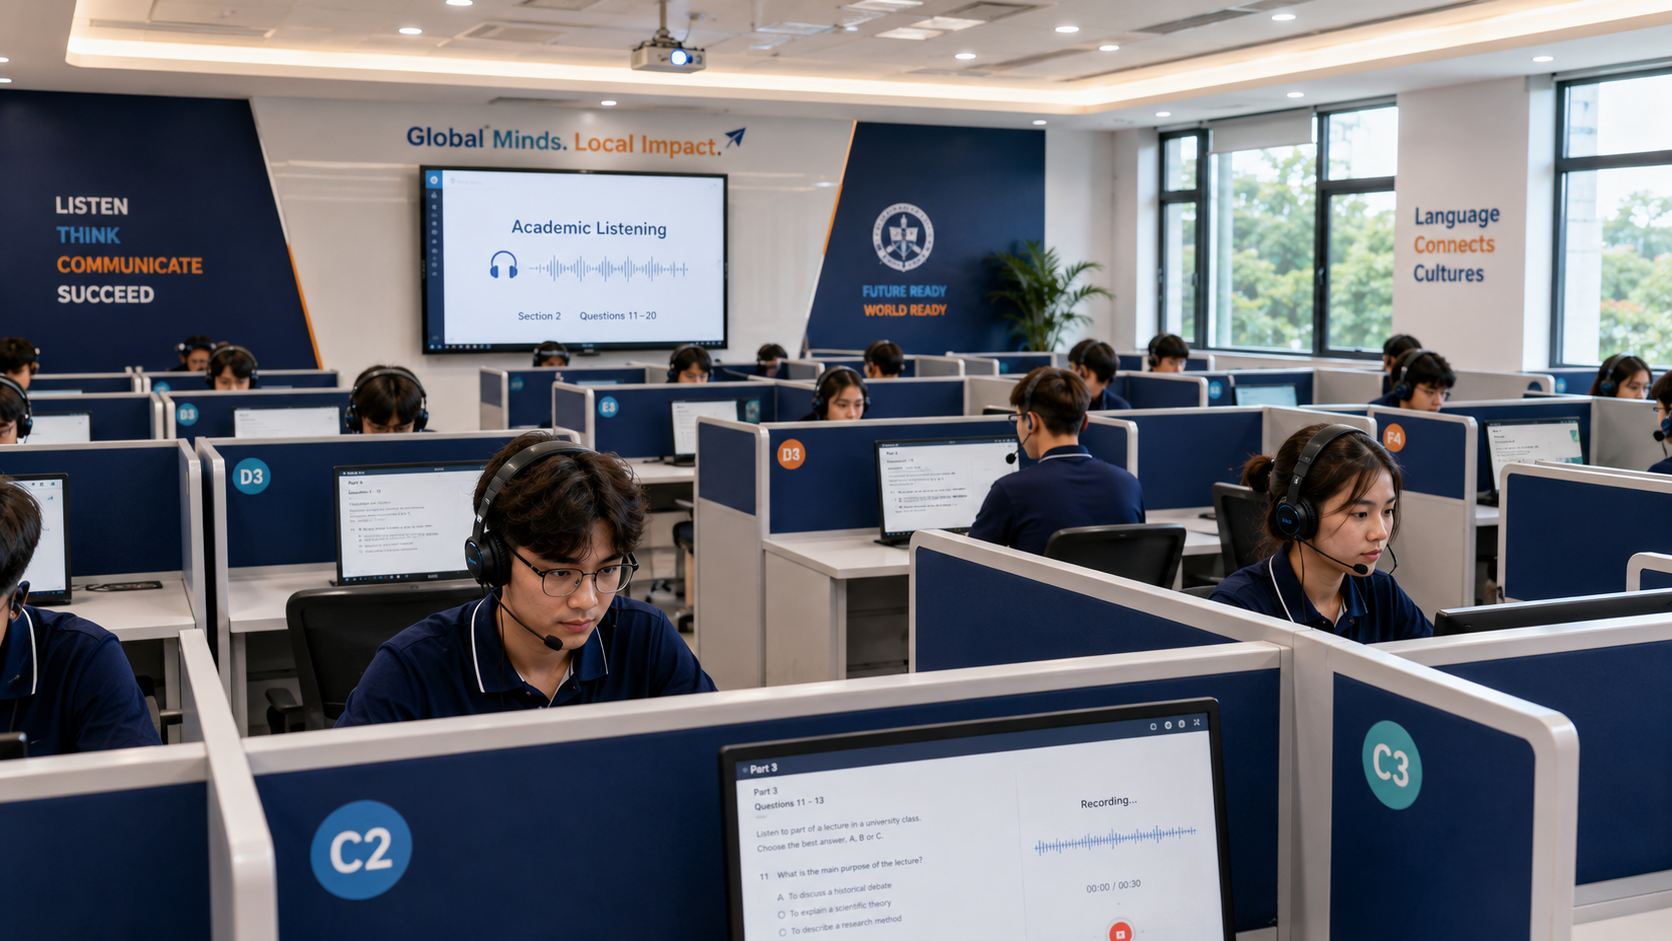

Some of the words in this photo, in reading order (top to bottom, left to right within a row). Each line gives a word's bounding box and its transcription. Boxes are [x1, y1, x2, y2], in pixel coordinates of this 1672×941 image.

[407, 126, 484, 148] Global
[493, 129, 568, 151] Minds.
[574, 132, 634, 154] Local
[642, 134, 722, 160] Impact.
[56, 196, 129, 216] LISTEN
[1415, 207, 1501, 229] Language
[56, 226, 121, 245] THINK
[511, 219, 591, 236] Academic
[596, 220, 668, 240] Listening
[1414, 235, 1496, 254] Connects
[57, 255, 204, 275] COMMUNICATE
[1413, 264, 1485, 283] Cultures
[57, 284, 155, 304] SUCCEED
[862, 285, 907, 298] FUTURE
[910, 284, 947, 298] READY
[518, 311, 554, 321] Section
[555, 311, 562, 321] 2
[579, 310, 626, 322] Questions
[863, 304, 908, 317] WORLD
[910, 304, 947, 317] READY
[180, 409, 195, 421] D3
[1387, 431, 1402, 445] F4
[783, 447, 801, 462] D3
[240, 468, 264, 486] D3
[750, 763, 770, 774] Part
[771, 763, 778, 772] 3
[1373, 743, 1409, 787] C3
[754, 788, 771, 796] Part
[773, 787, 778, 795] 3
[754, 799, 795, 811] Questions
[797, 798, 806, 806] 11
[815, 797, 825, 805] 13
[1081, 796, 1138, 809] Recording...
[756, 829, 779, 838] Listen
[781, 828, 789, 836] to
[791, 826, 806, 837] part
[808, 825, 816, 833] of
[824, 821, 849, 831] lecture
[851, 820, 858, 828] in
[866, 817, 900, 830] university
[902, 814, 922, 824] class.
[330, 827, 393, 874] C2
[757, 842, 786, 852] Choose
[788, 841, 800, 849] the
[802, 839, 818, 848] best
[867, 833, 875, 841] or
[777, 870, 797, 879] What
[800, 868, 806, 876] is
[807, 867, 819, 876] the
[821, 866, 839, 874] main
[841, 863, 870, 873] purpose
[872, 861, 880, 869] of
[881, 859, 893, 868] the
[895, 856, 923, 866] lecture?
[789, 892, 798, 900] To
[800, 889, 826, 899] discuss
[834, 884, 866, 895] historical
[868, 882, 892, 891] debate
[1086, 883, 1111, 894] 00:00
[1112, 882, 1116, 891] /
[1118, 879, 1142, 890] 00:30
[801, 907, 827, 916] explain
[835, 902, 867, 912] scientific
[869, 899, 892, 909] theory
[792, 927, 801, 935] To
[802, 923, 834, 934] describe
[842, 918, 873, 929] research
[875, 915, 902, 925] method
